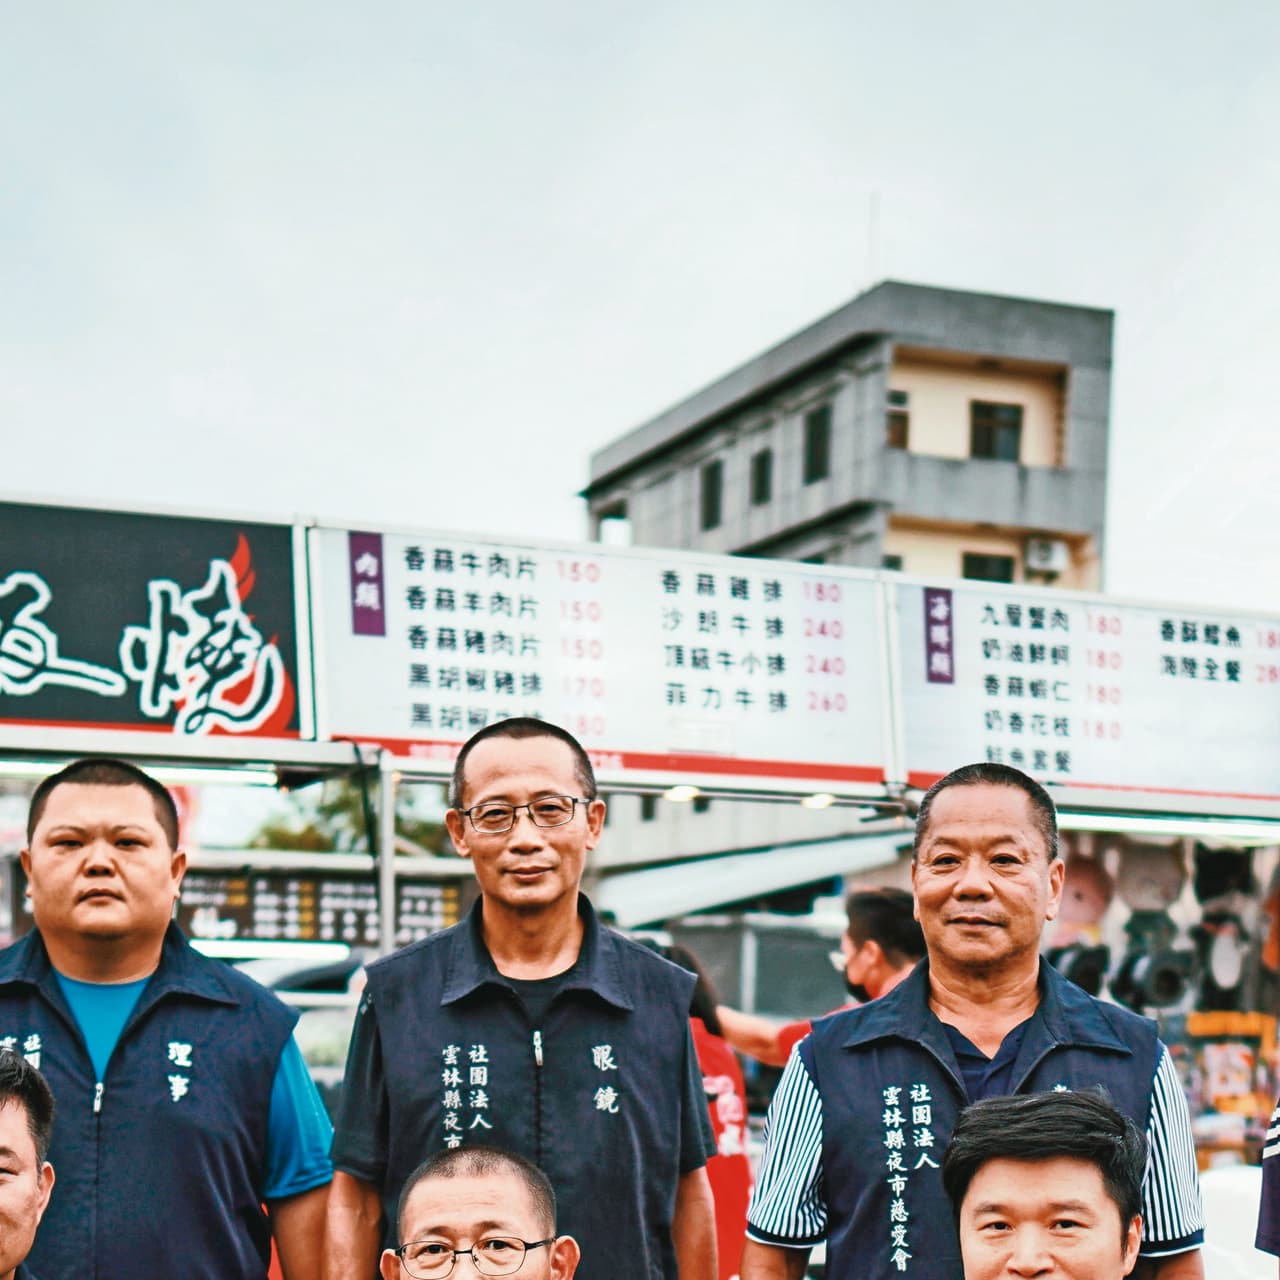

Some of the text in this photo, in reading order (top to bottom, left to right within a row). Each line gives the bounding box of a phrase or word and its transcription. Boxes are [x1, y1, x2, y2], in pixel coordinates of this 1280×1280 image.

[558, 560, 601, 582] 150
[804, 582, 841, 602] 180
[804, 618, 843, 639] 240
[806, 654, 845, 675] 240
[411, 703, 542, 730] 黑胡椒
[441, 1044, 464, 1149] 雲林縣夜市
[468, 1044, 494, 1129] 社團法人
[592, 1044, 620, 1114] 眼鏡
[909, 1083, 941, 1170] 社團法人
[882, 1085, 913, 1273] 雲林縣夜市慈愛會
